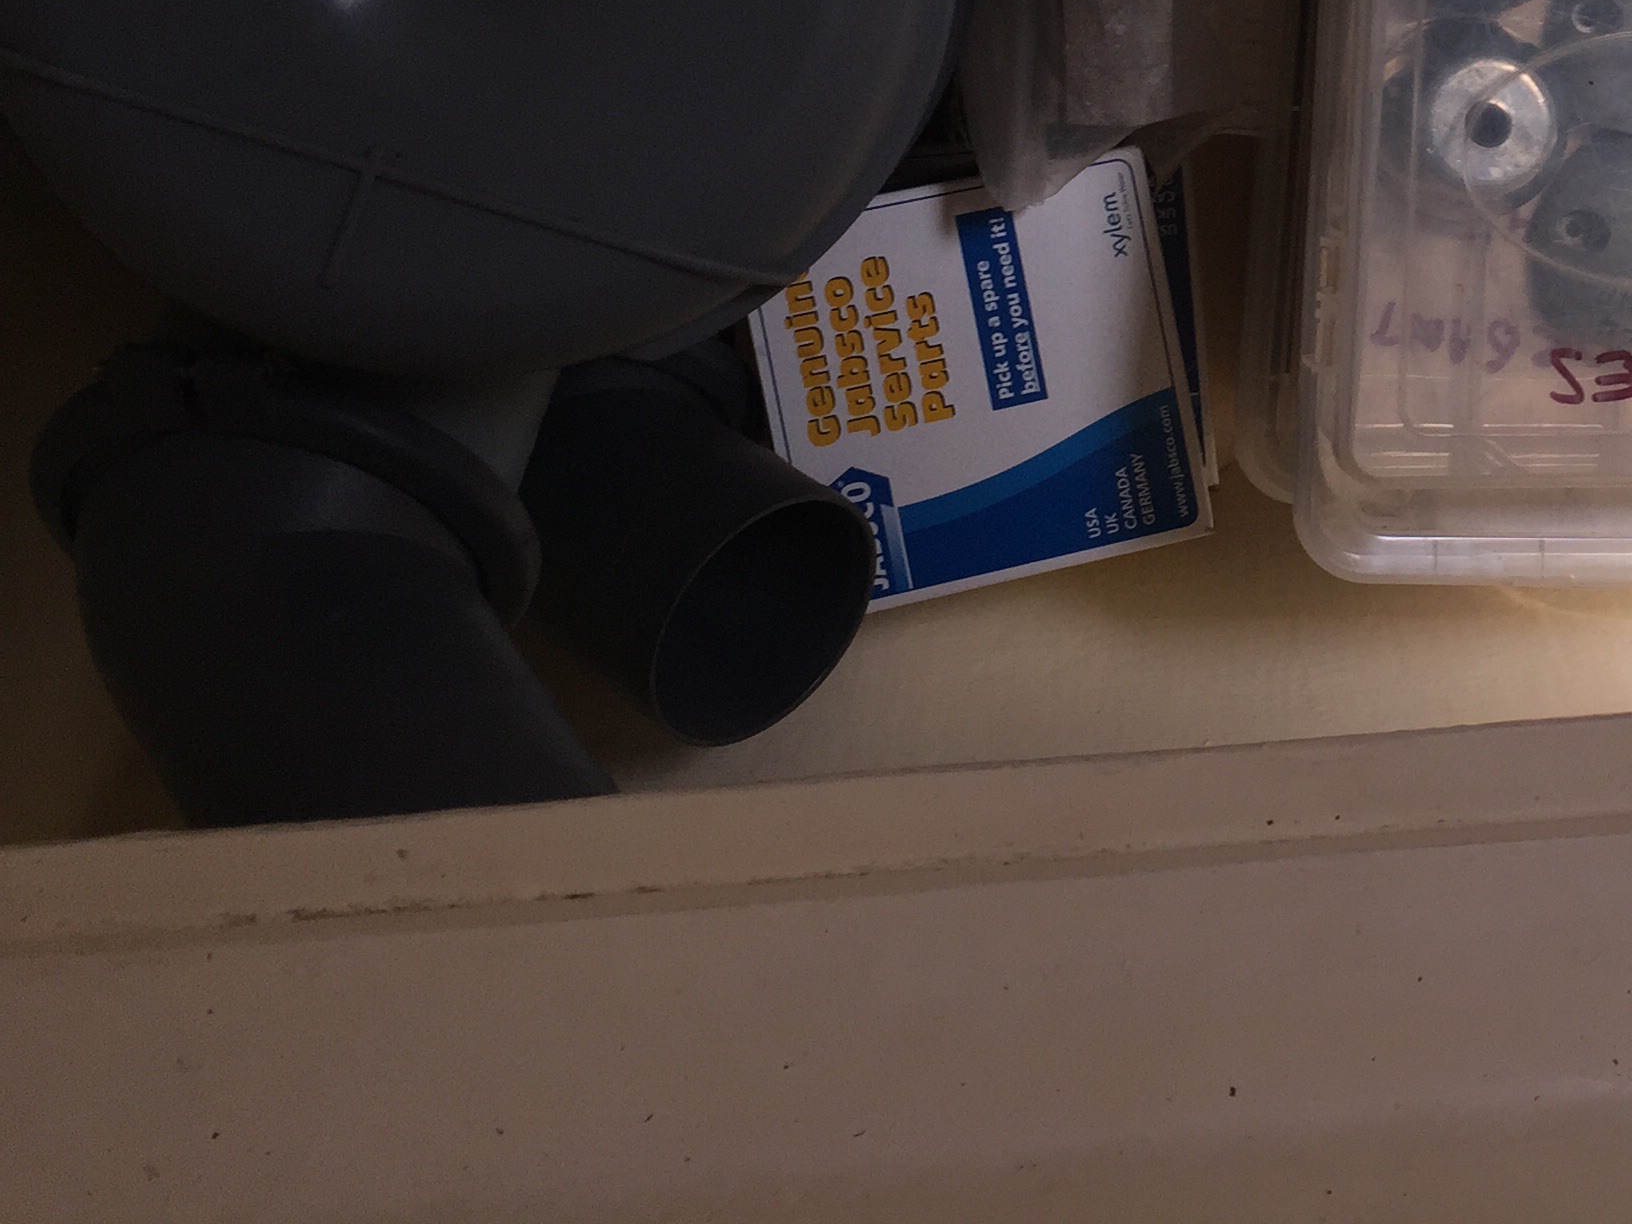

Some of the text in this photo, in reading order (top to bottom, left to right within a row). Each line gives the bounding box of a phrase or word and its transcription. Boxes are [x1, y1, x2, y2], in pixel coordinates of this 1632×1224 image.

[1102, 192, 1132, 258] xylem
[784, 270, 841, 447] Genuin
[823, 276, 880, 437] Jabsco
[859, 256, 918, 431] Service
[906, 292, 954, 424] Parts
[976, 260, 1014, 400] Pick up a spare
[988, 217, 1041, 394] before you need it!
[1084, 507, 1101, 538] USA
[1114, 466, 1137, 529] CANADA
[1130, 454, 1156, 525] GERMANY
[1158, 404, 1189, 518] www.jabsco.com
[1104, 512, 1120, 534] UK
